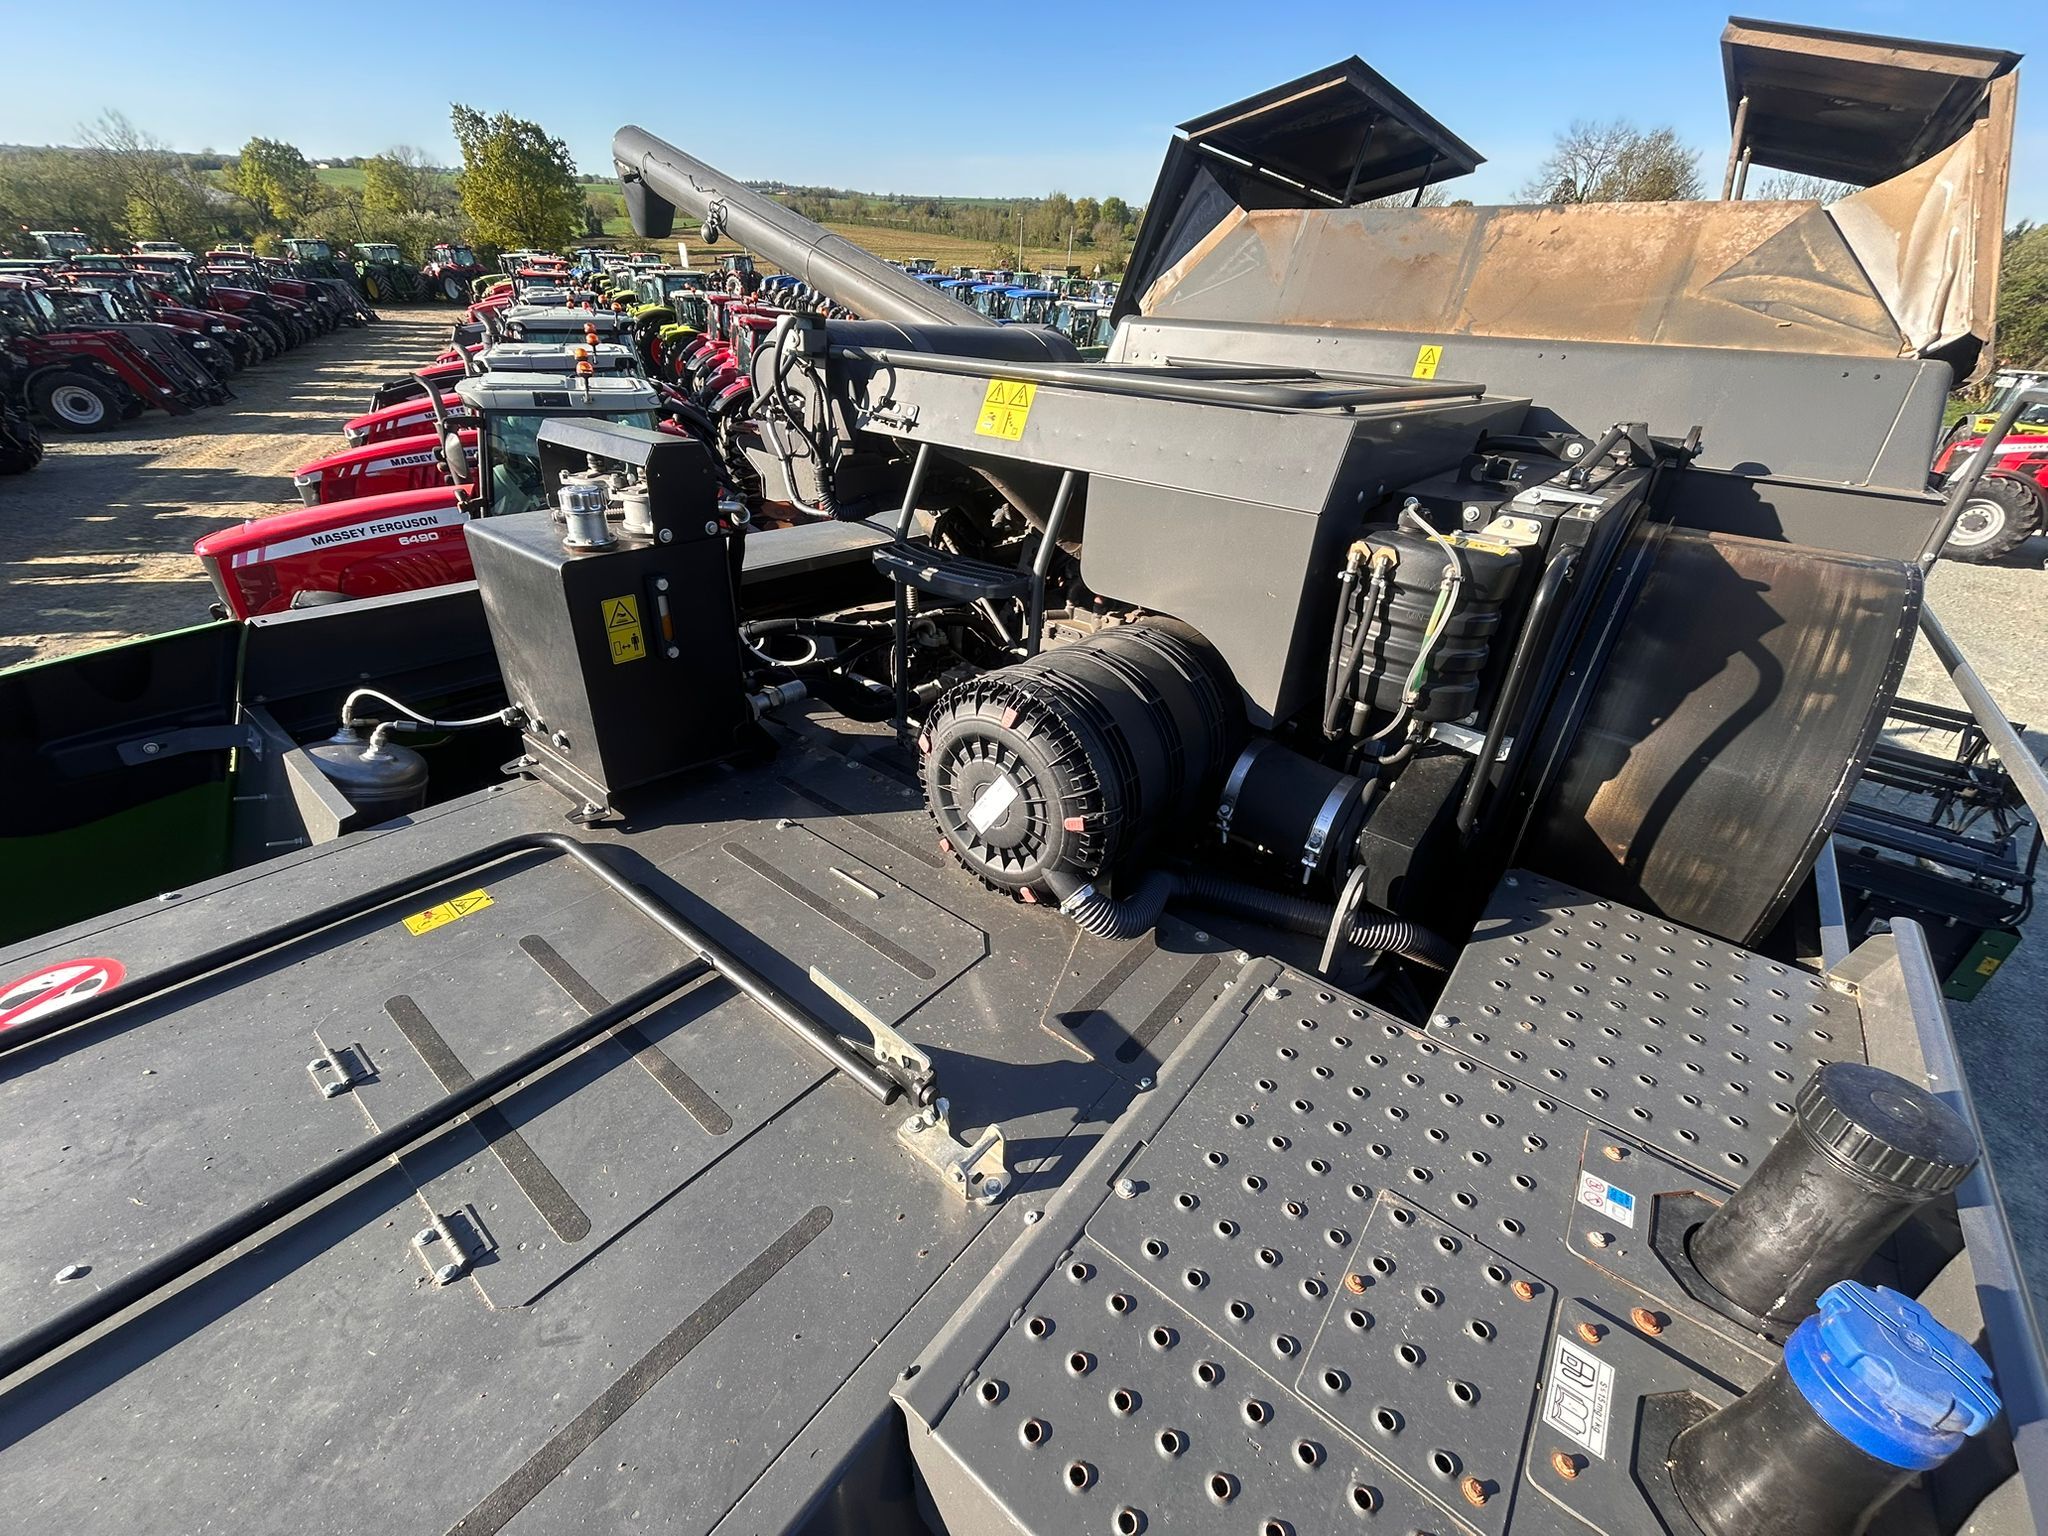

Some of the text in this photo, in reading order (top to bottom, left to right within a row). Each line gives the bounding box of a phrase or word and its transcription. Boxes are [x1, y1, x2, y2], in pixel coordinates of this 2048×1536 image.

[424, 408, 454, 419] MAY
[390, 454, 432, 466] MASSEY
[311, 527, 367, 546] MASSEY
[370, 516, 439, 535] FERGUSON
[399, 532, 439, 546] 6490
